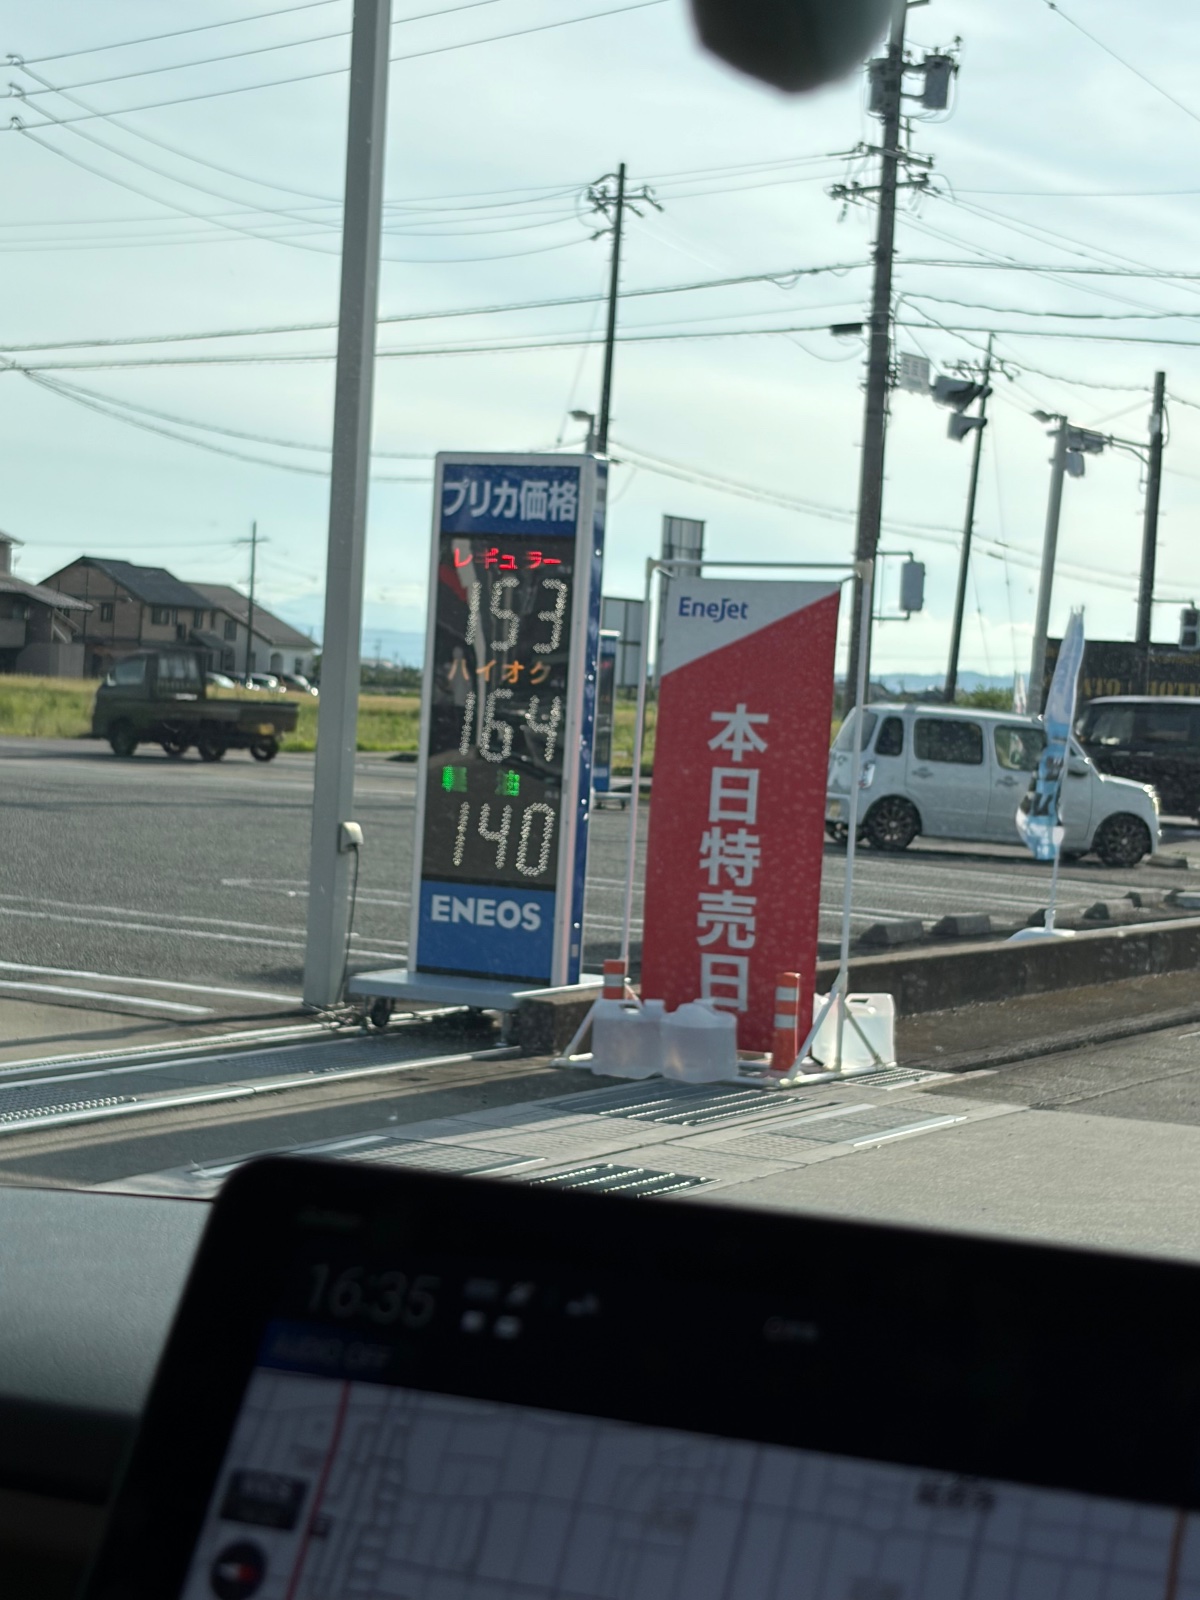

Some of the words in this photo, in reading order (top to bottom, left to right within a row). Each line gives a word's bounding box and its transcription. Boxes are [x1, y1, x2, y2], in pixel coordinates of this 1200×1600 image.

[443, 480, 577, 522] プリカ価格
[464, 576, 568, 654] 153
[677, 596, 749, 623] EneJet
[448, 658, 552, 684] ハイオク
[458, 687, 562, 763] 164
[452, 801, 556, 878] 140
[696, 703, 770, 1016] 本日特売日
[431, 894, 541, 932] ENEOS
